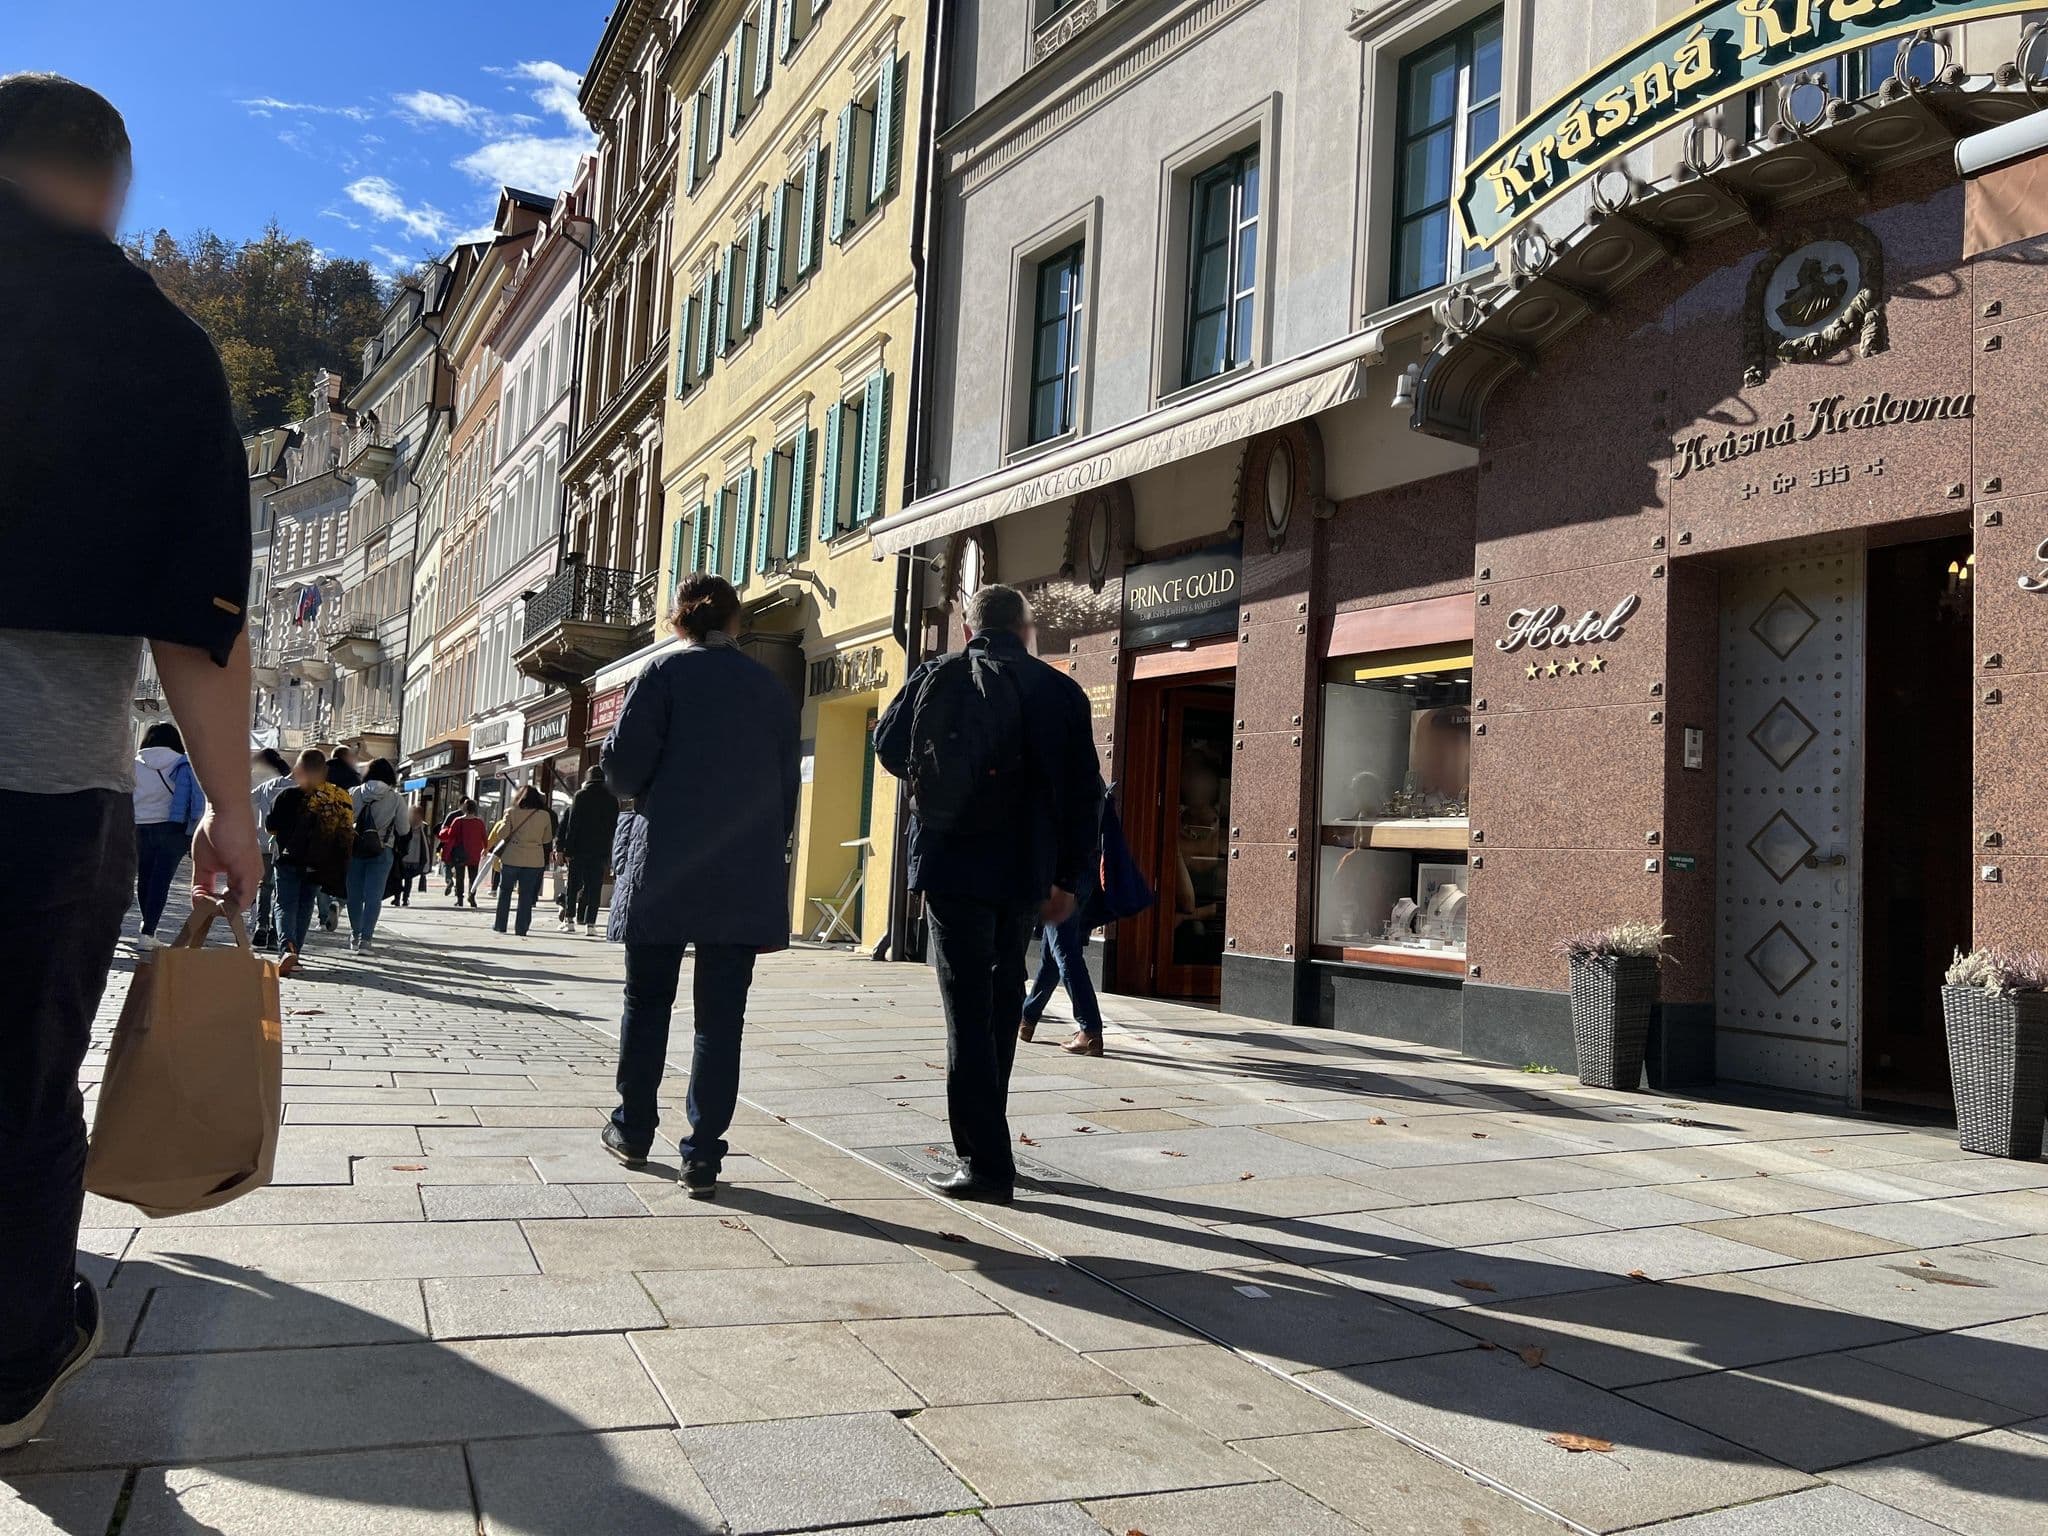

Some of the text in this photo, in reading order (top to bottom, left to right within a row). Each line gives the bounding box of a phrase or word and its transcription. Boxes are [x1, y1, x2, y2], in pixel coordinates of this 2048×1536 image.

[1484, 25, 1714, 213] Krásná
[1014, 472, 1065, 508] PRINCE
[1067, 456, 1112, 490] GOLD
[1150, 430, 1197, 455] EXQUSITE
[1671, 392, 1976, 479] Krásná Královna
[1809, 464, 1850, 488] 335
[1129, 568, 1235, 611] PRINCE GOLD
[1495, 593, 1637, 651] Hotel
